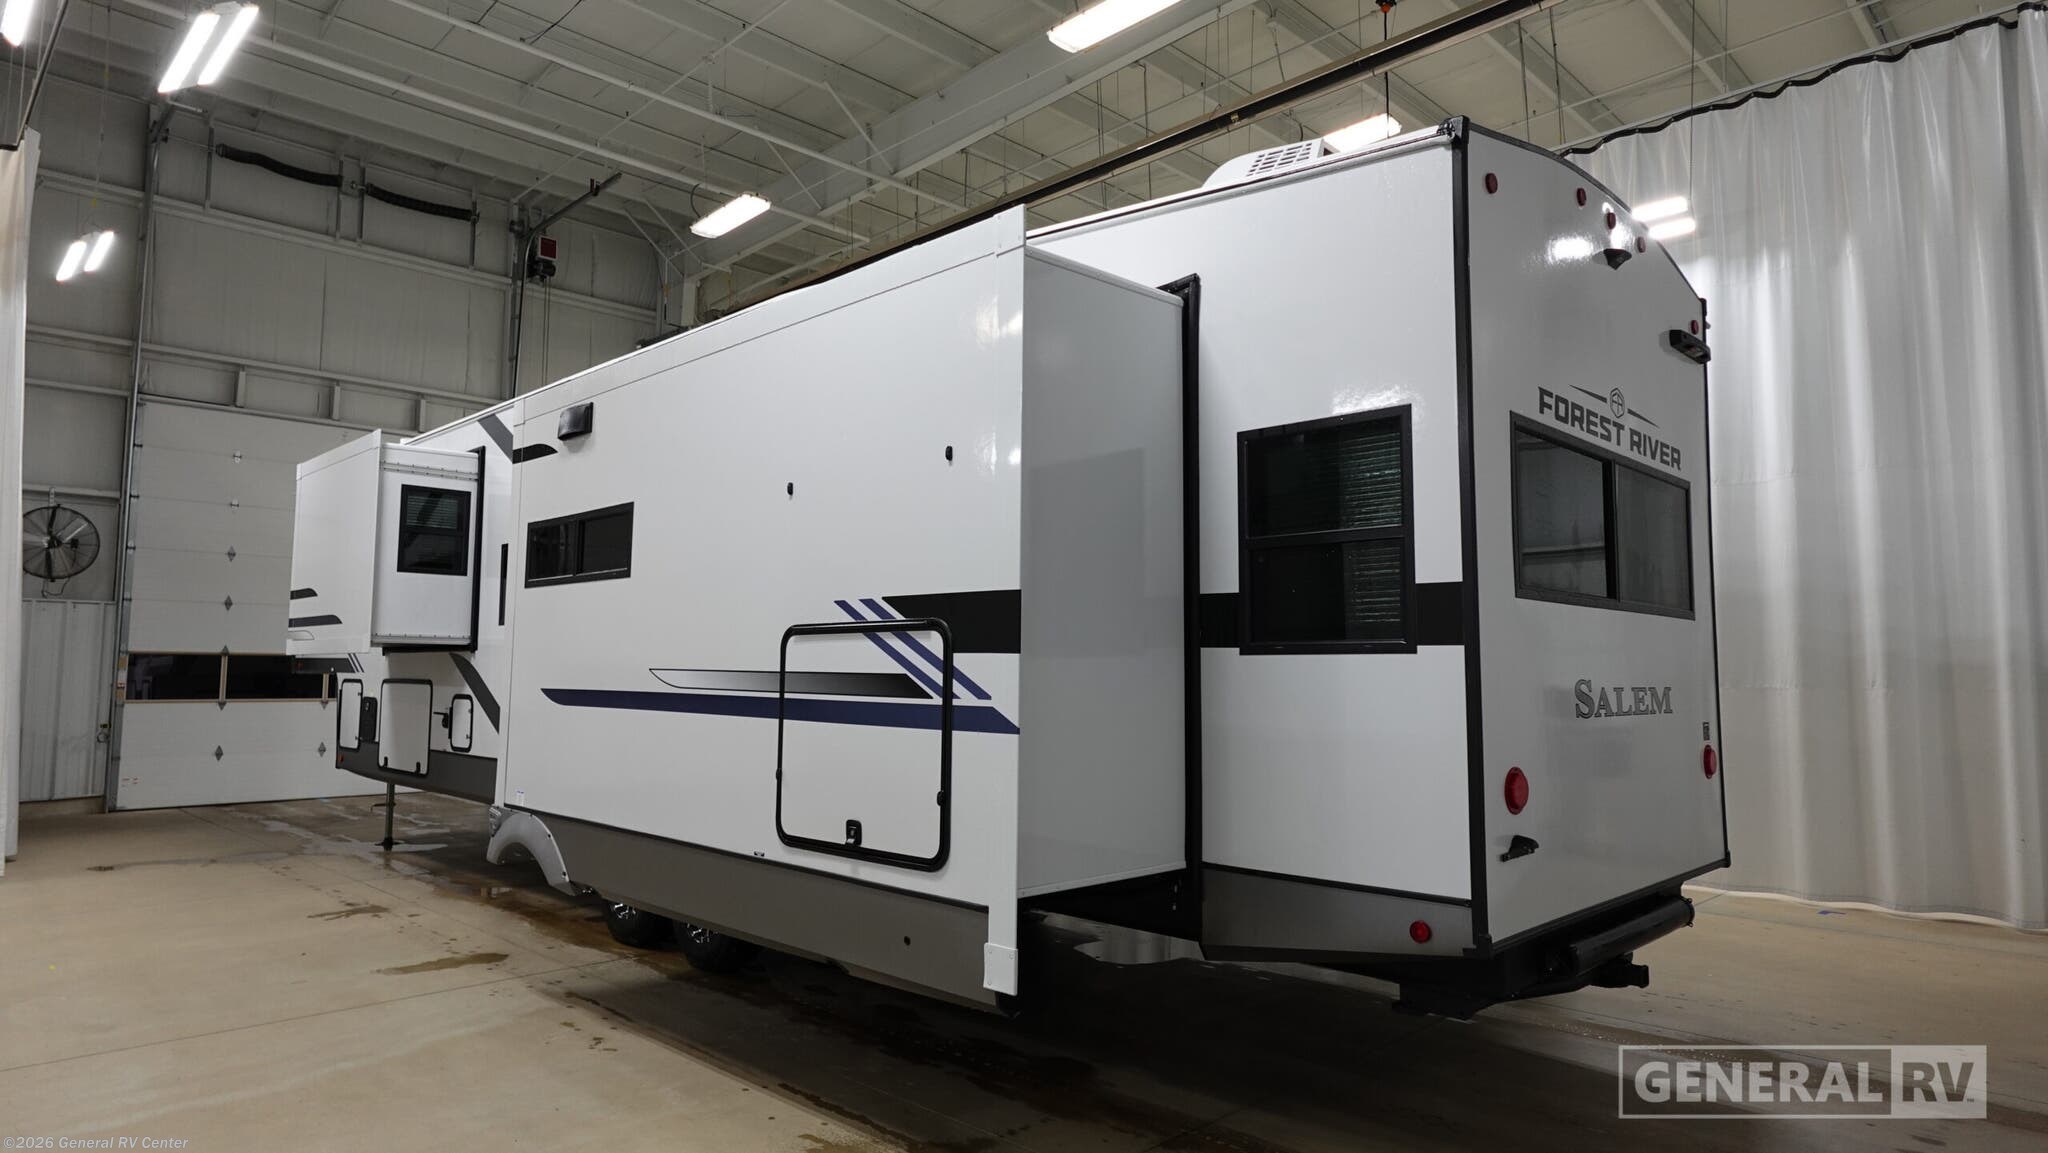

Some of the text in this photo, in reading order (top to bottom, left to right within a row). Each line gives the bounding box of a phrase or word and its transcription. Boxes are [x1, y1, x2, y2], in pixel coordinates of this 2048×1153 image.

[1537, 385, 1681, 470] FOREST RIVER
[1574, 678, 1673, 719] SALEM
